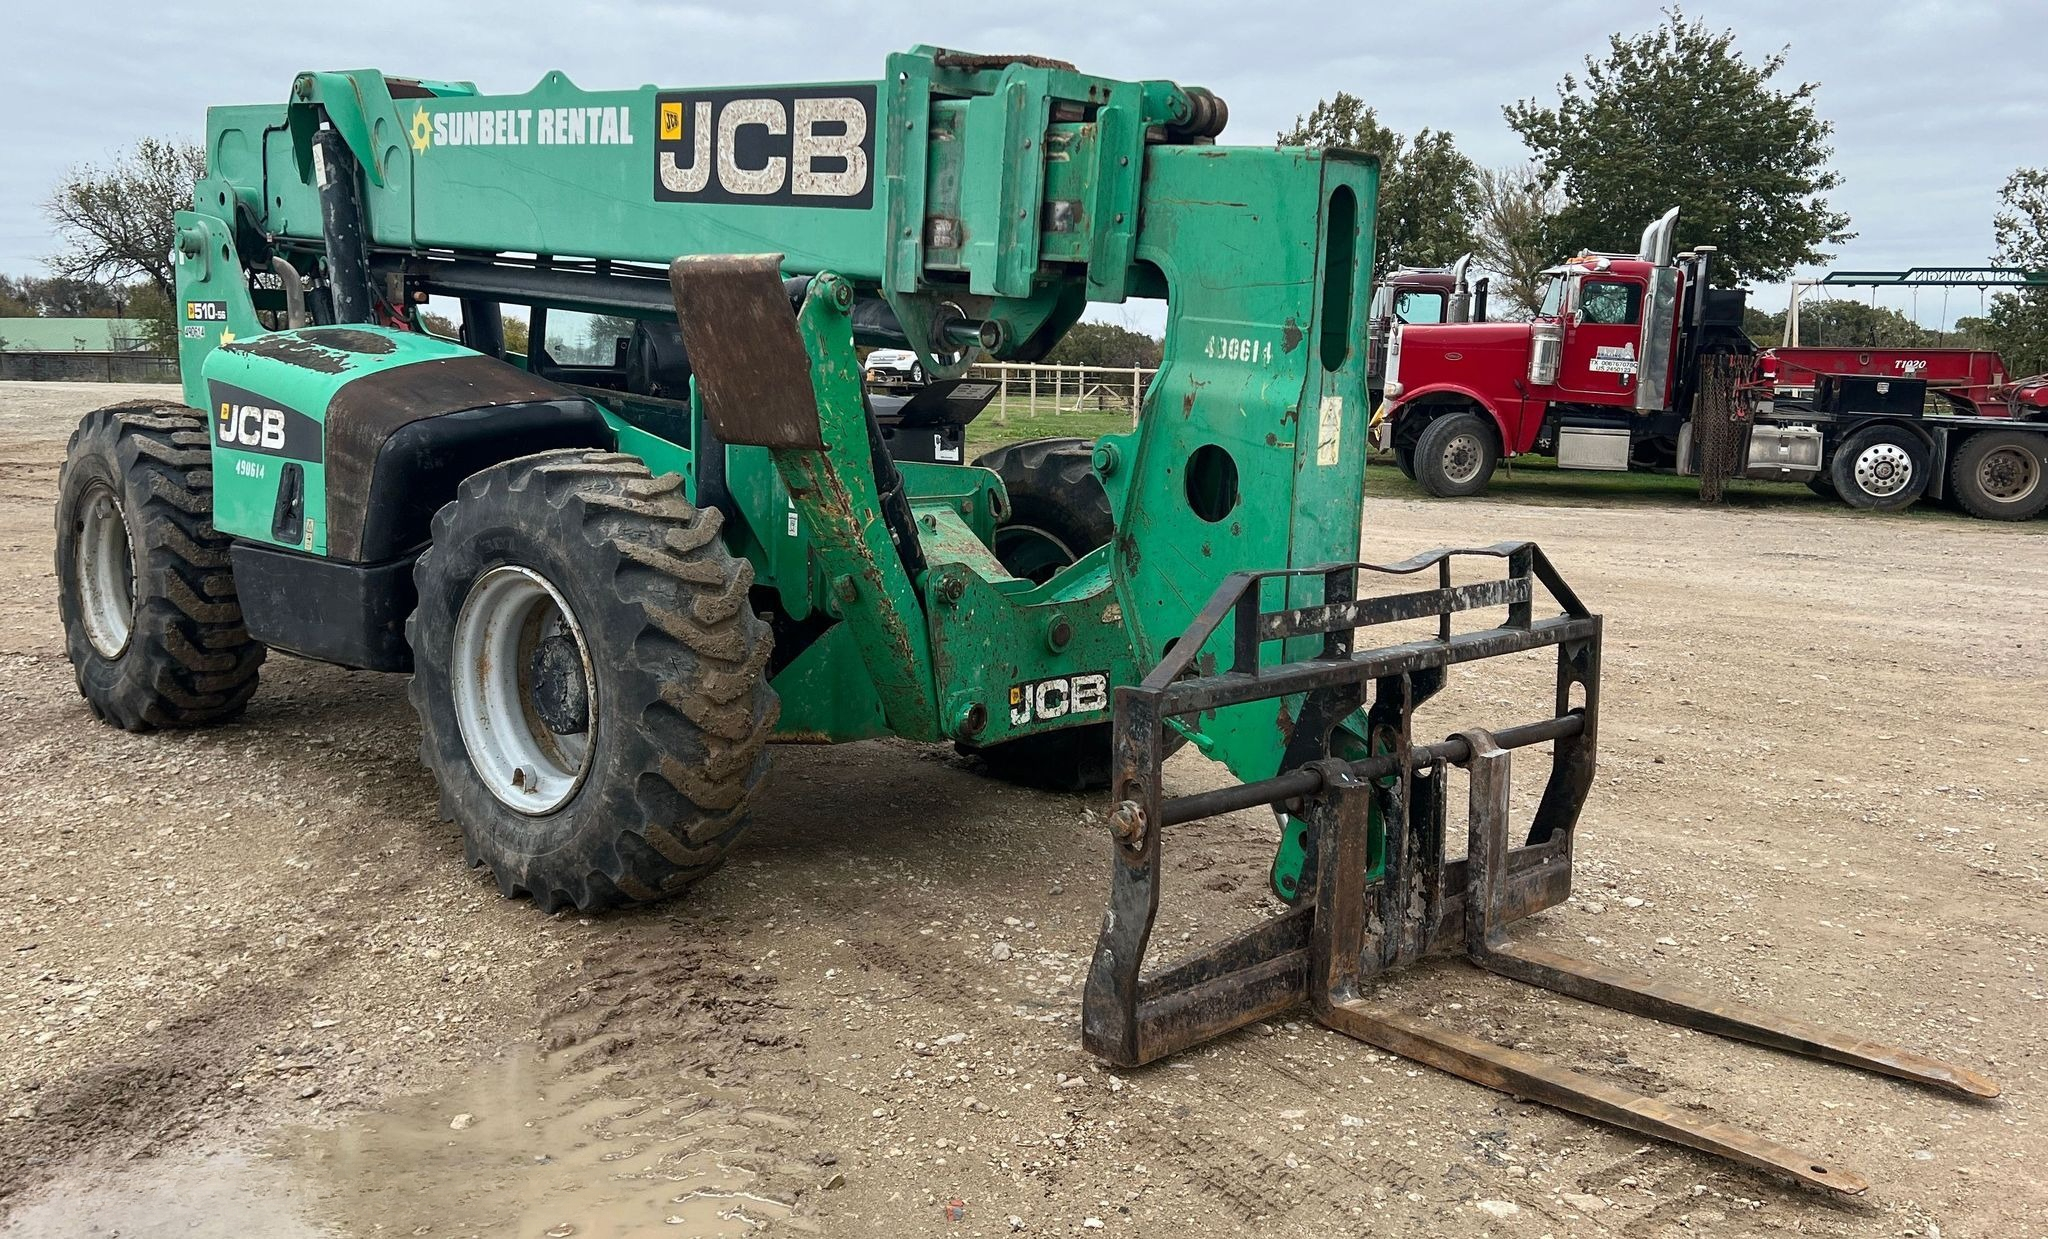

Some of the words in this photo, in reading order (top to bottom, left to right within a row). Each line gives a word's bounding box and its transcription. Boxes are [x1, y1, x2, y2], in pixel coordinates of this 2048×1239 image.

[433, 109, 532, 146] SUNBELT
[537, 106, 634, 145] RENTAL
[659, 97, 868, 197] JCB
[219, 403, 286, 450] JCB
[235, 459, 265, 479] 490614
[1010, 674, 1107, 726] JCB
